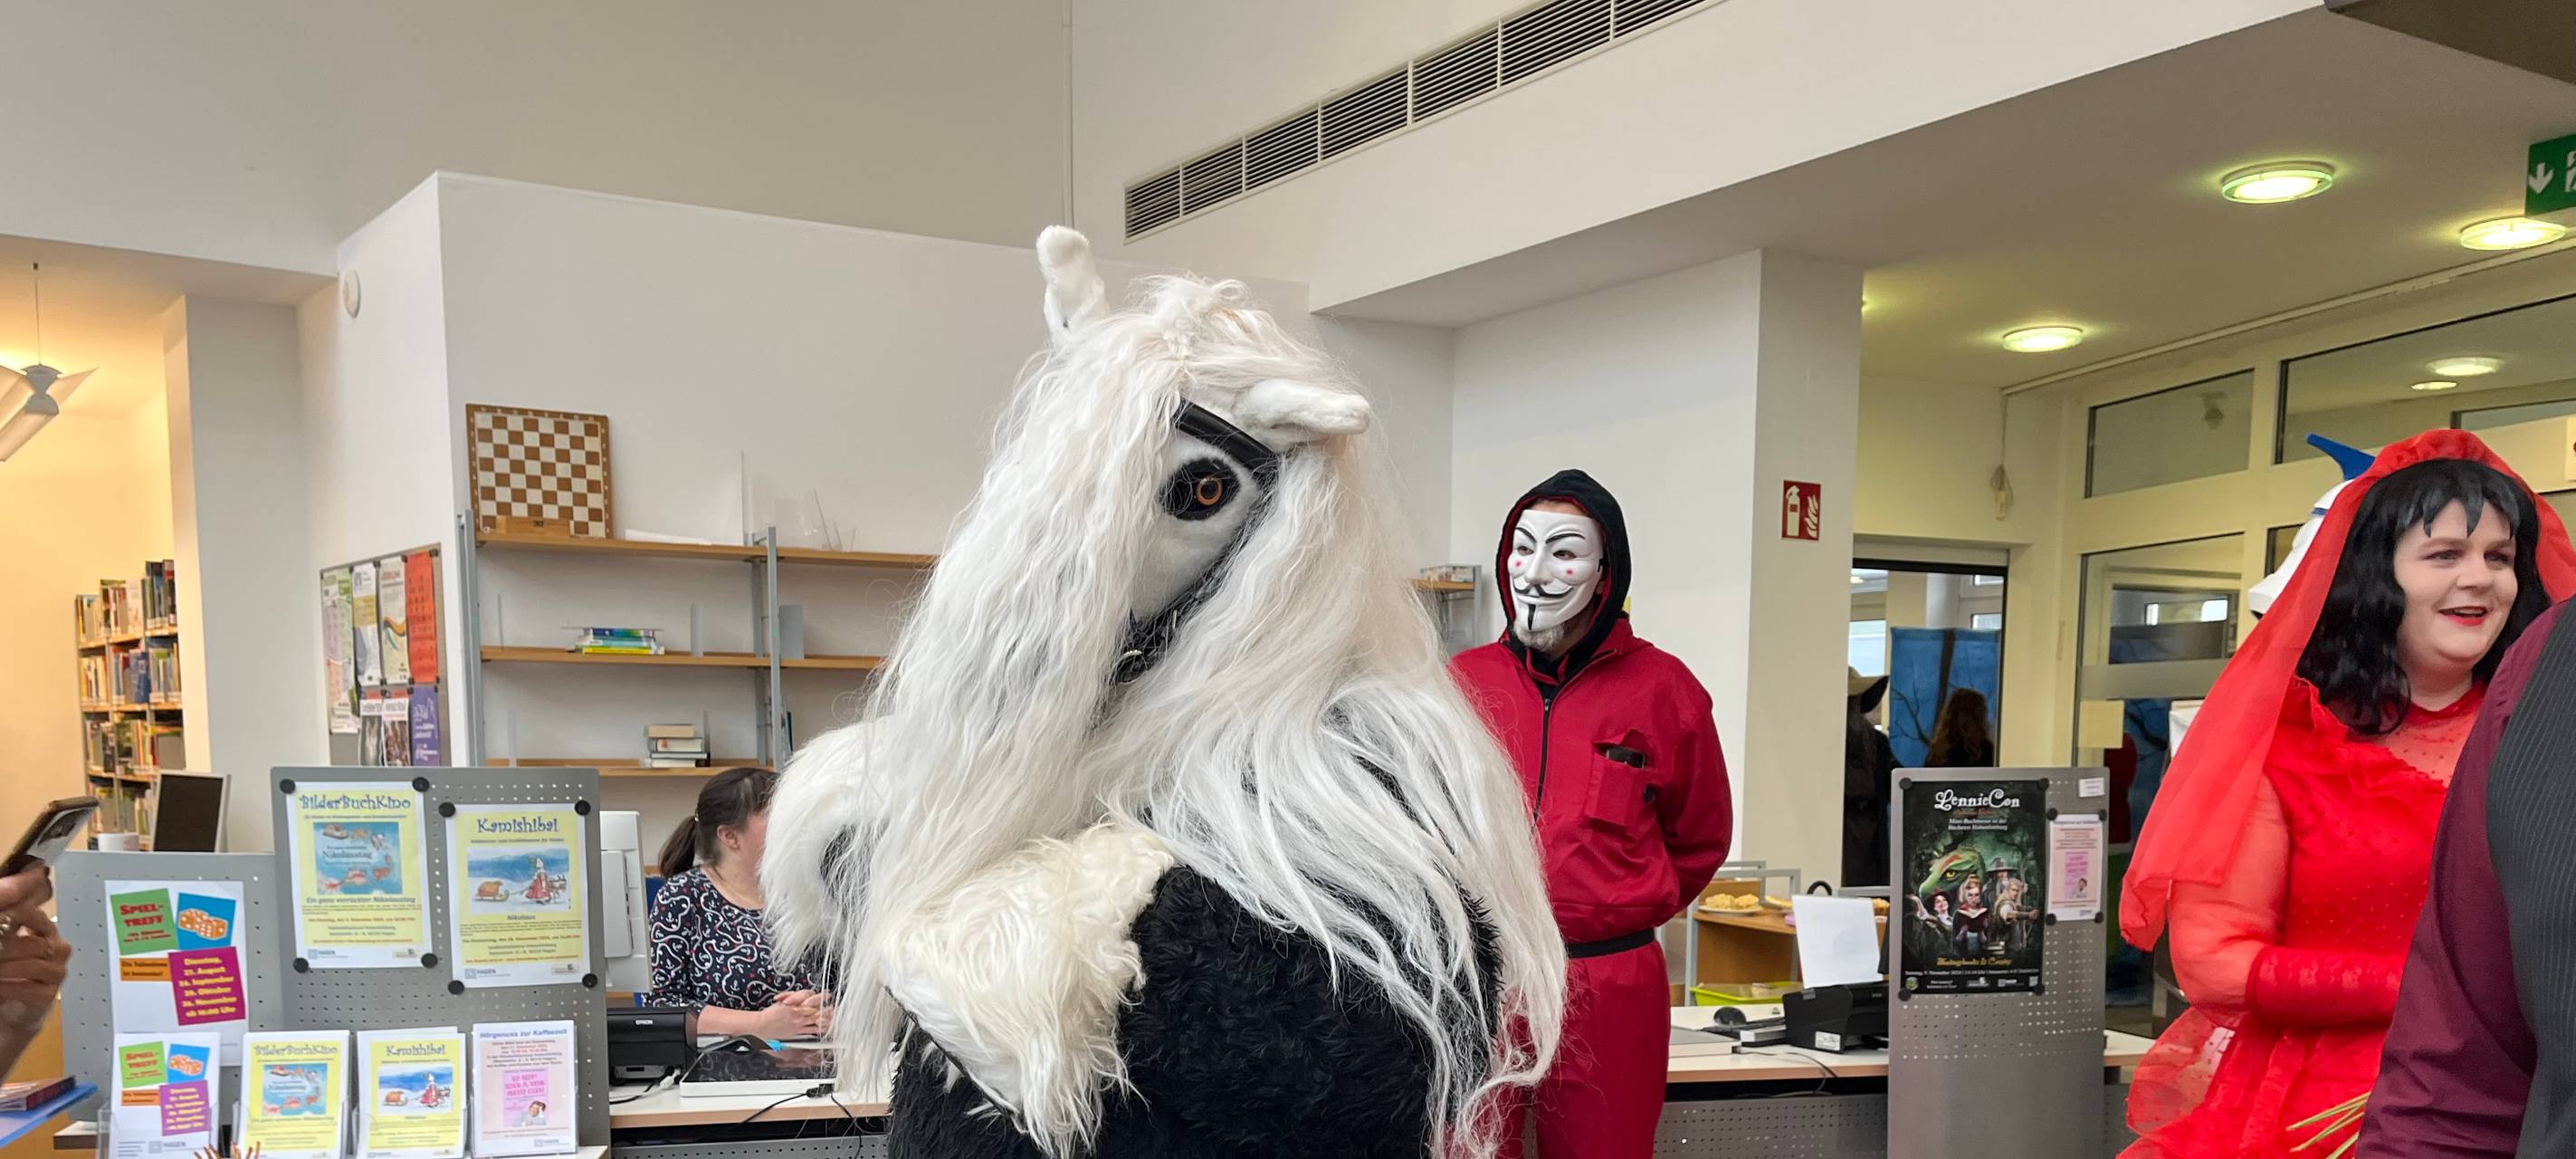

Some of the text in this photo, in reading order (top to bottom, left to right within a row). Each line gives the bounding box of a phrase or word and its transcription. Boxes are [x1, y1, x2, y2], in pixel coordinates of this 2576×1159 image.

[300, 794, 411, 809] BilderBuchKino
[1934, 789, 2020, 810] LennieCon
[477, 816, 558, 833] Kamishibai
